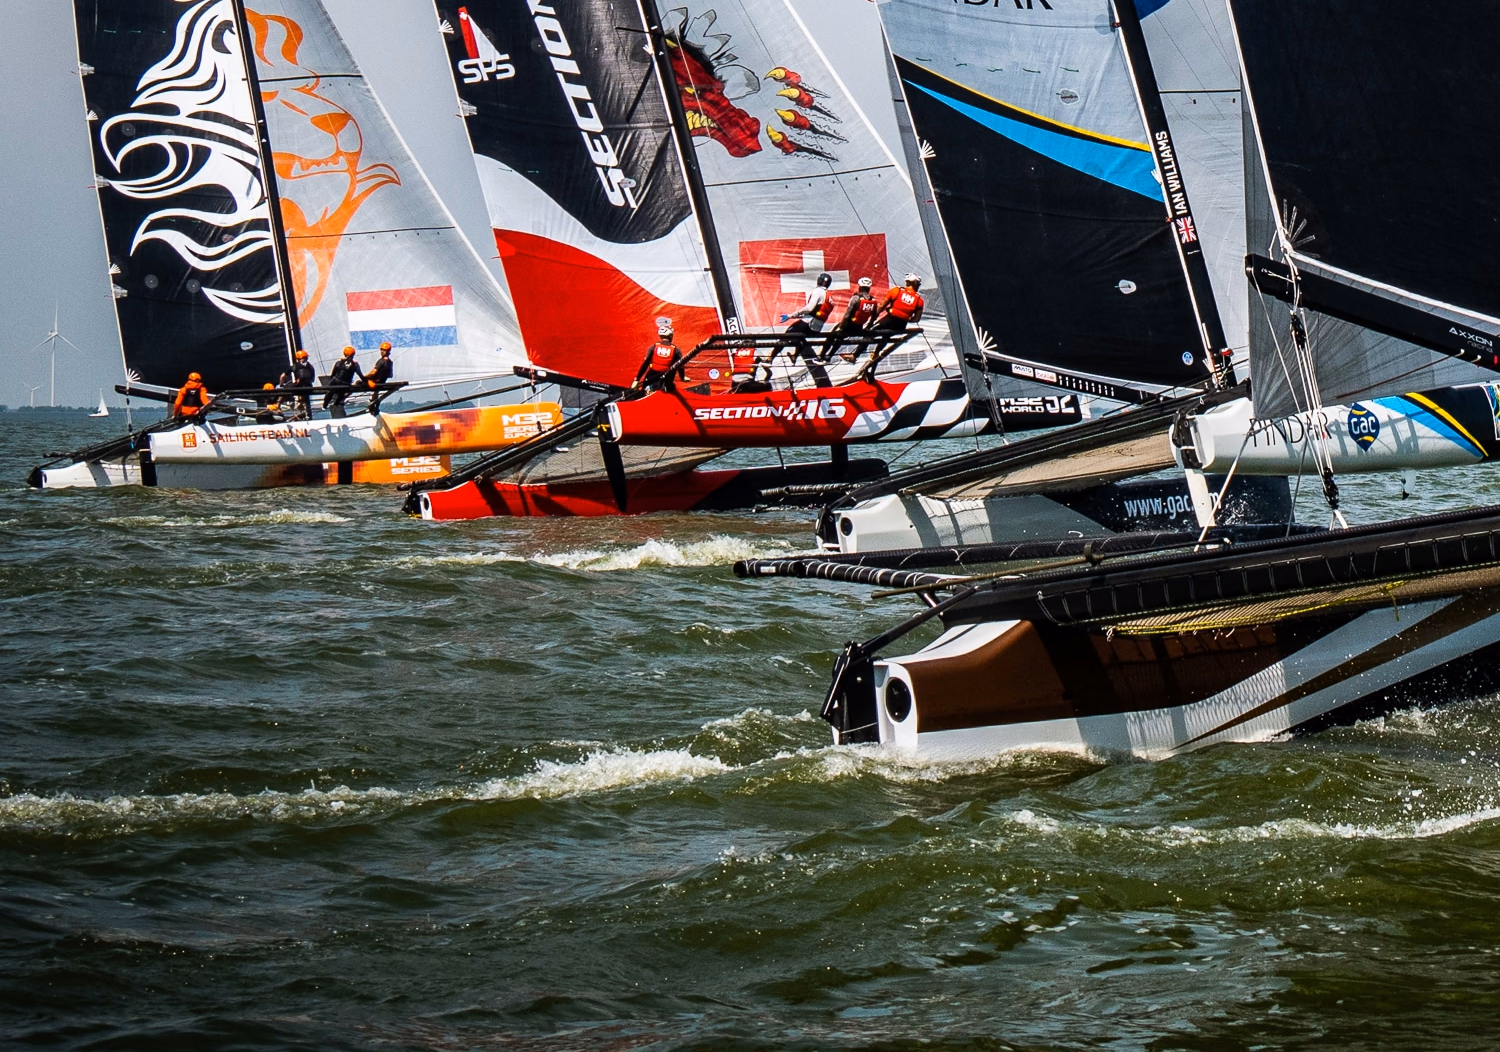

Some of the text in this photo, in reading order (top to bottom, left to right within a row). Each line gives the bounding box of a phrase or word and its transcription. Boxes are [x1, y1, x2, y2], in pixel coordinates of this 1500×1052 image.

[457, 53, 516, 84] SPS
[1155, 131, 1188, 215] IAN WILLIAMS
[1449, 327, 1493, 347] AXXON
[694, 398, 847, 420] SECTION 16
[1001, 405, 1044, 413] WORLD
[502, 412, 554, 426] M32
[209, 427, 312, 444] SAILING TEAM NL
[391, 455, 440, 467] M32
[391, 465, 441, 474] SERIES
[1124, 491, 1222, 520] www.gac.m
